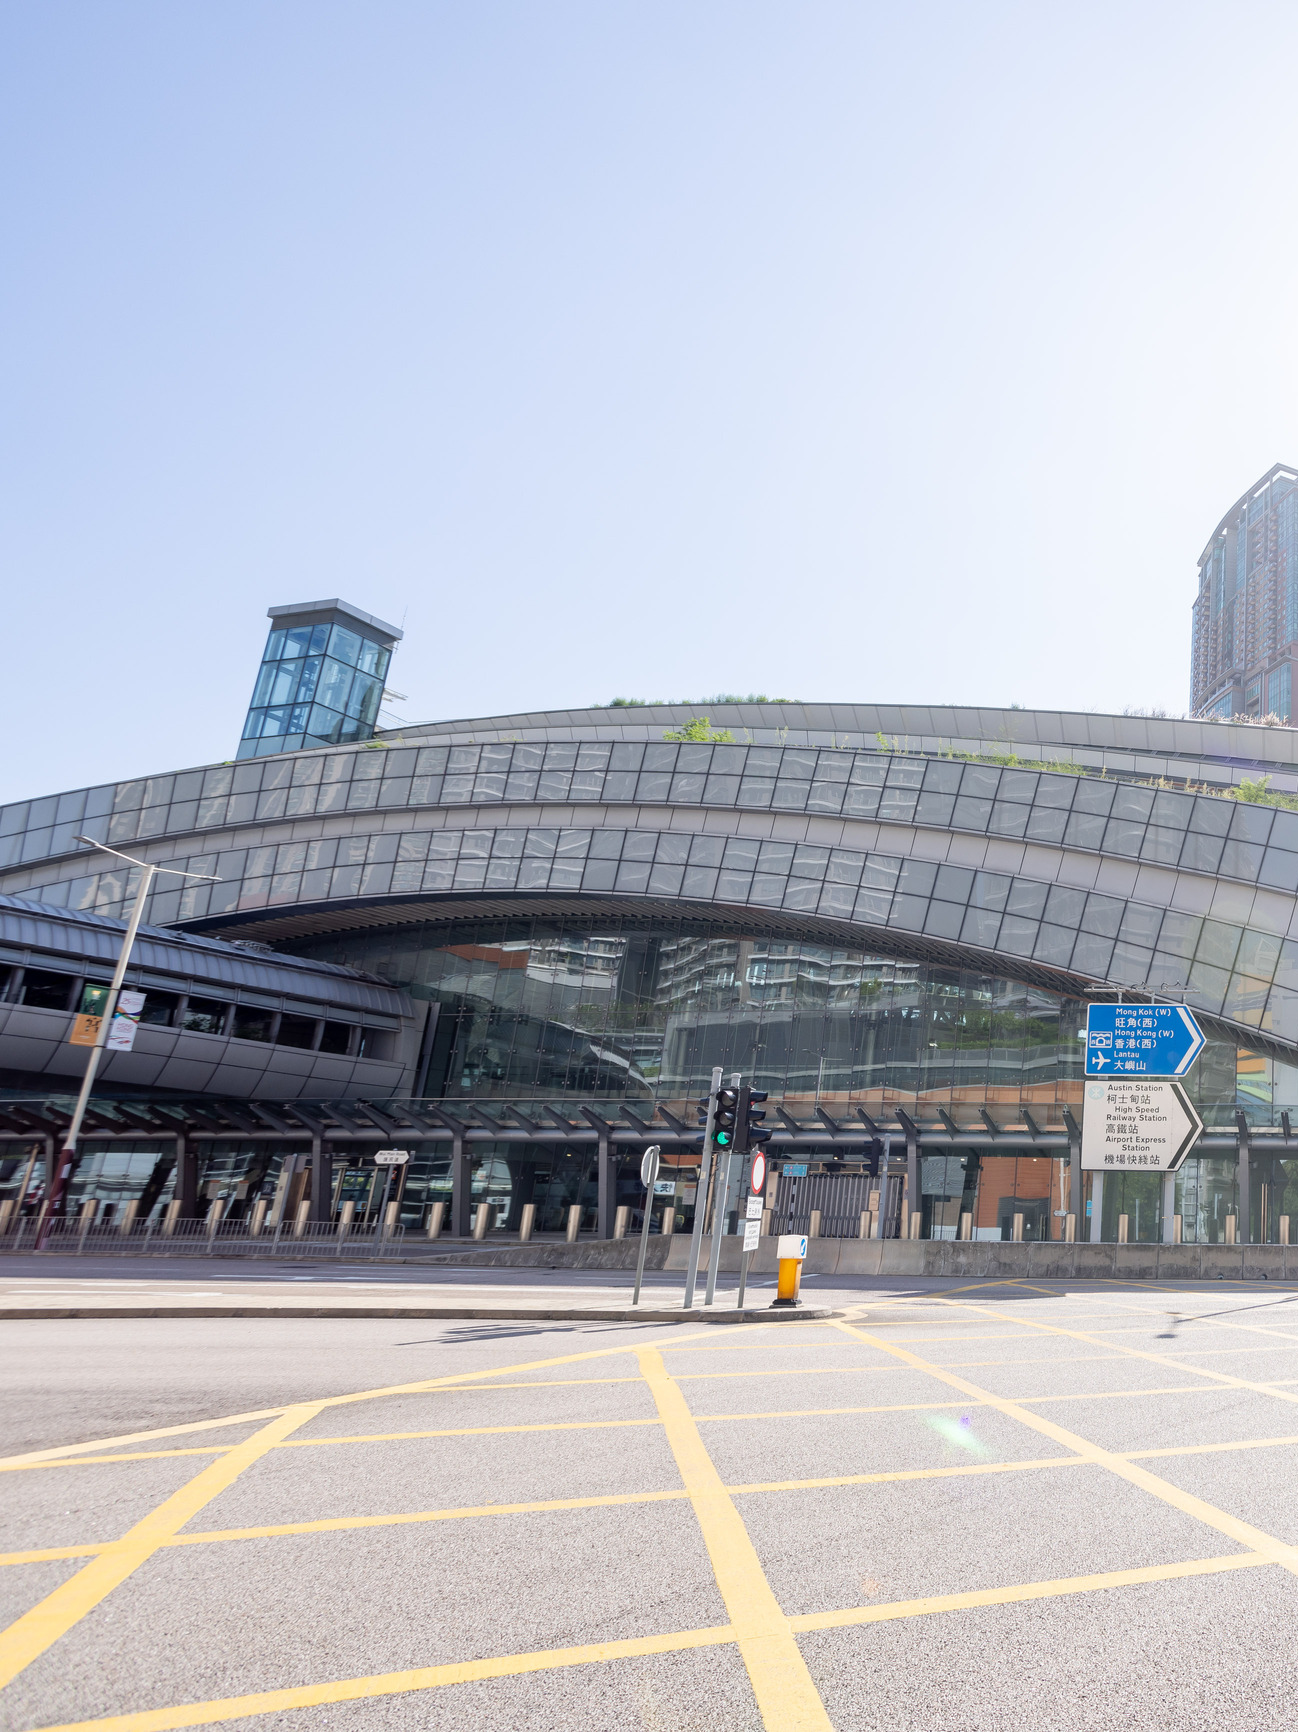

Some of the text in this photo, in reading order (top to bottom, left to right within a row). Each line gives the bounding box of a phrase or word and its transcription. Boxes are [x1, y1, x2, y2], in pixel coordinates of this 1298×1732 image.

[1116, 1008, 1136, 1016] Mong
[1115, 1018, 1157, 1028] 旺角(西)
[1137, 1030, 1156, 1038] Kong
[1115, 1039, 1156, 1049] 香港(西)
[1114, 1060, 1146, 1070] 大嶼山
[1107, 1094, 1150, 1104] 柯士甸站
[1106, 1124, 1138, 1134] 高鐵站
